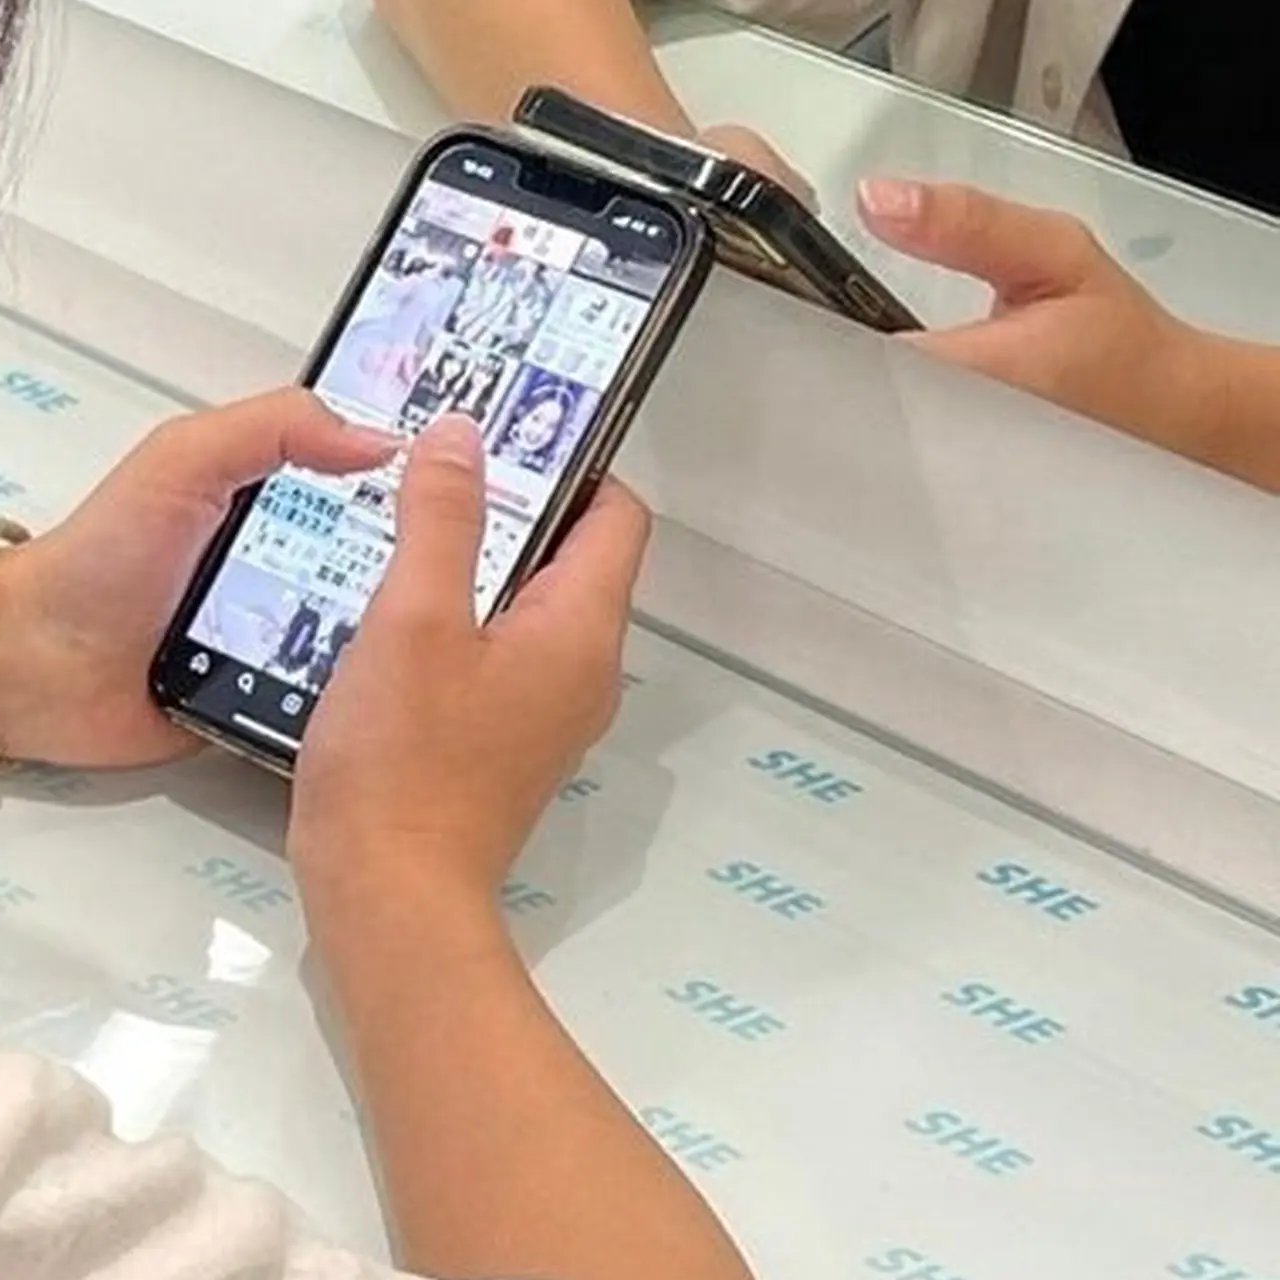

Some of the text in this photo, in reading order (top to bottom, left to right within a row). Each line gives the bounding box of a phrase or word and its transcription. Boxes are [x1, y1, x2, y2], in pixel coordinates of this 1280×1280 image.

[746, 750, 865, 803] SHE
[183, 857, 294, 913] SHE
[705, 861, 830, 920] SHE
[977, 863, 1101, 922] SHE
[665, 980, 787, 1041] SHE
[941, 983, 1068, 1044] SHE
[904, 1111, 1035, 1174] SHE
[1195, 1115, 1280, 1174] SH
